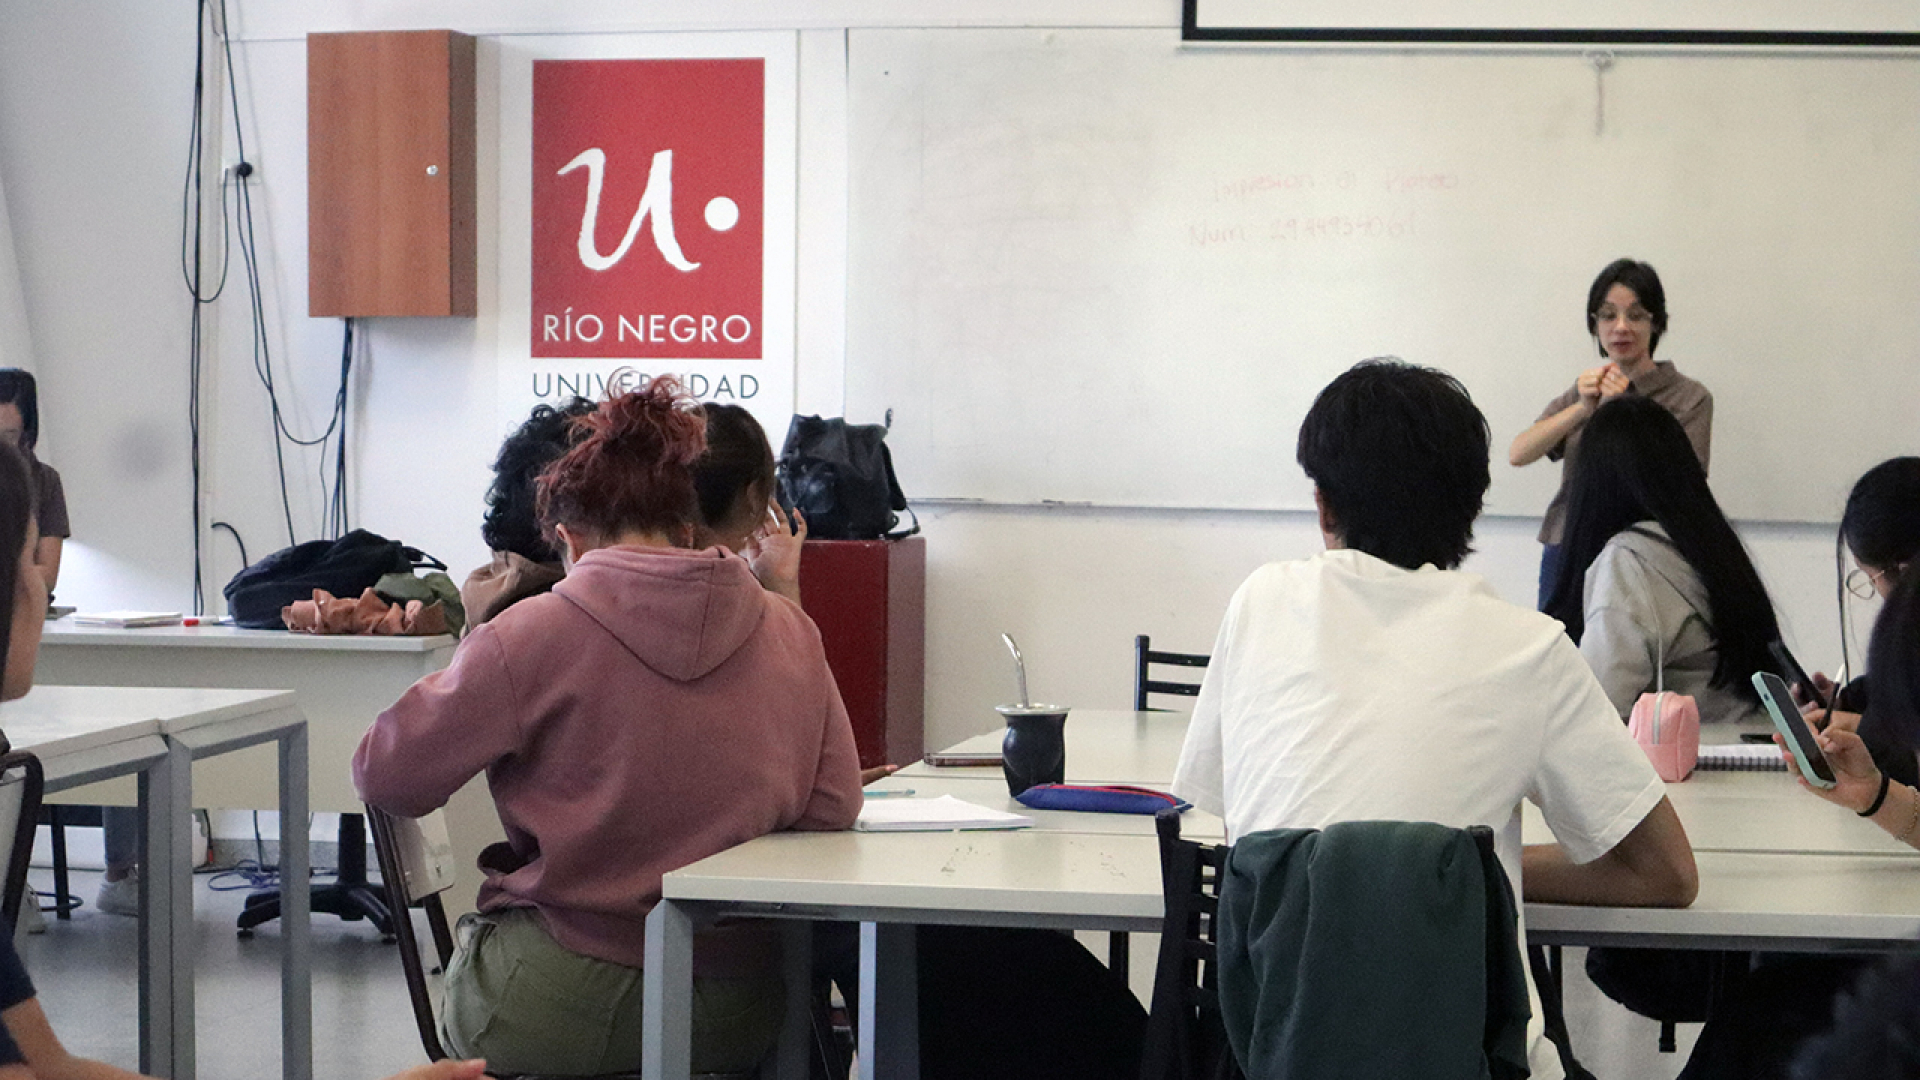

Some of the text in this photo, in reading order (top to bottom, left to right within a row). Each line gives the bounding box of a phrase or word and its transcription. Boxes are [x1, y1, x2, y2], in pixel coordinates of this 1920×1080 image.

[543, 307, 751, 343] RÍO NEGRO
[532, 372, 760, 399] UNIVERIDAD
